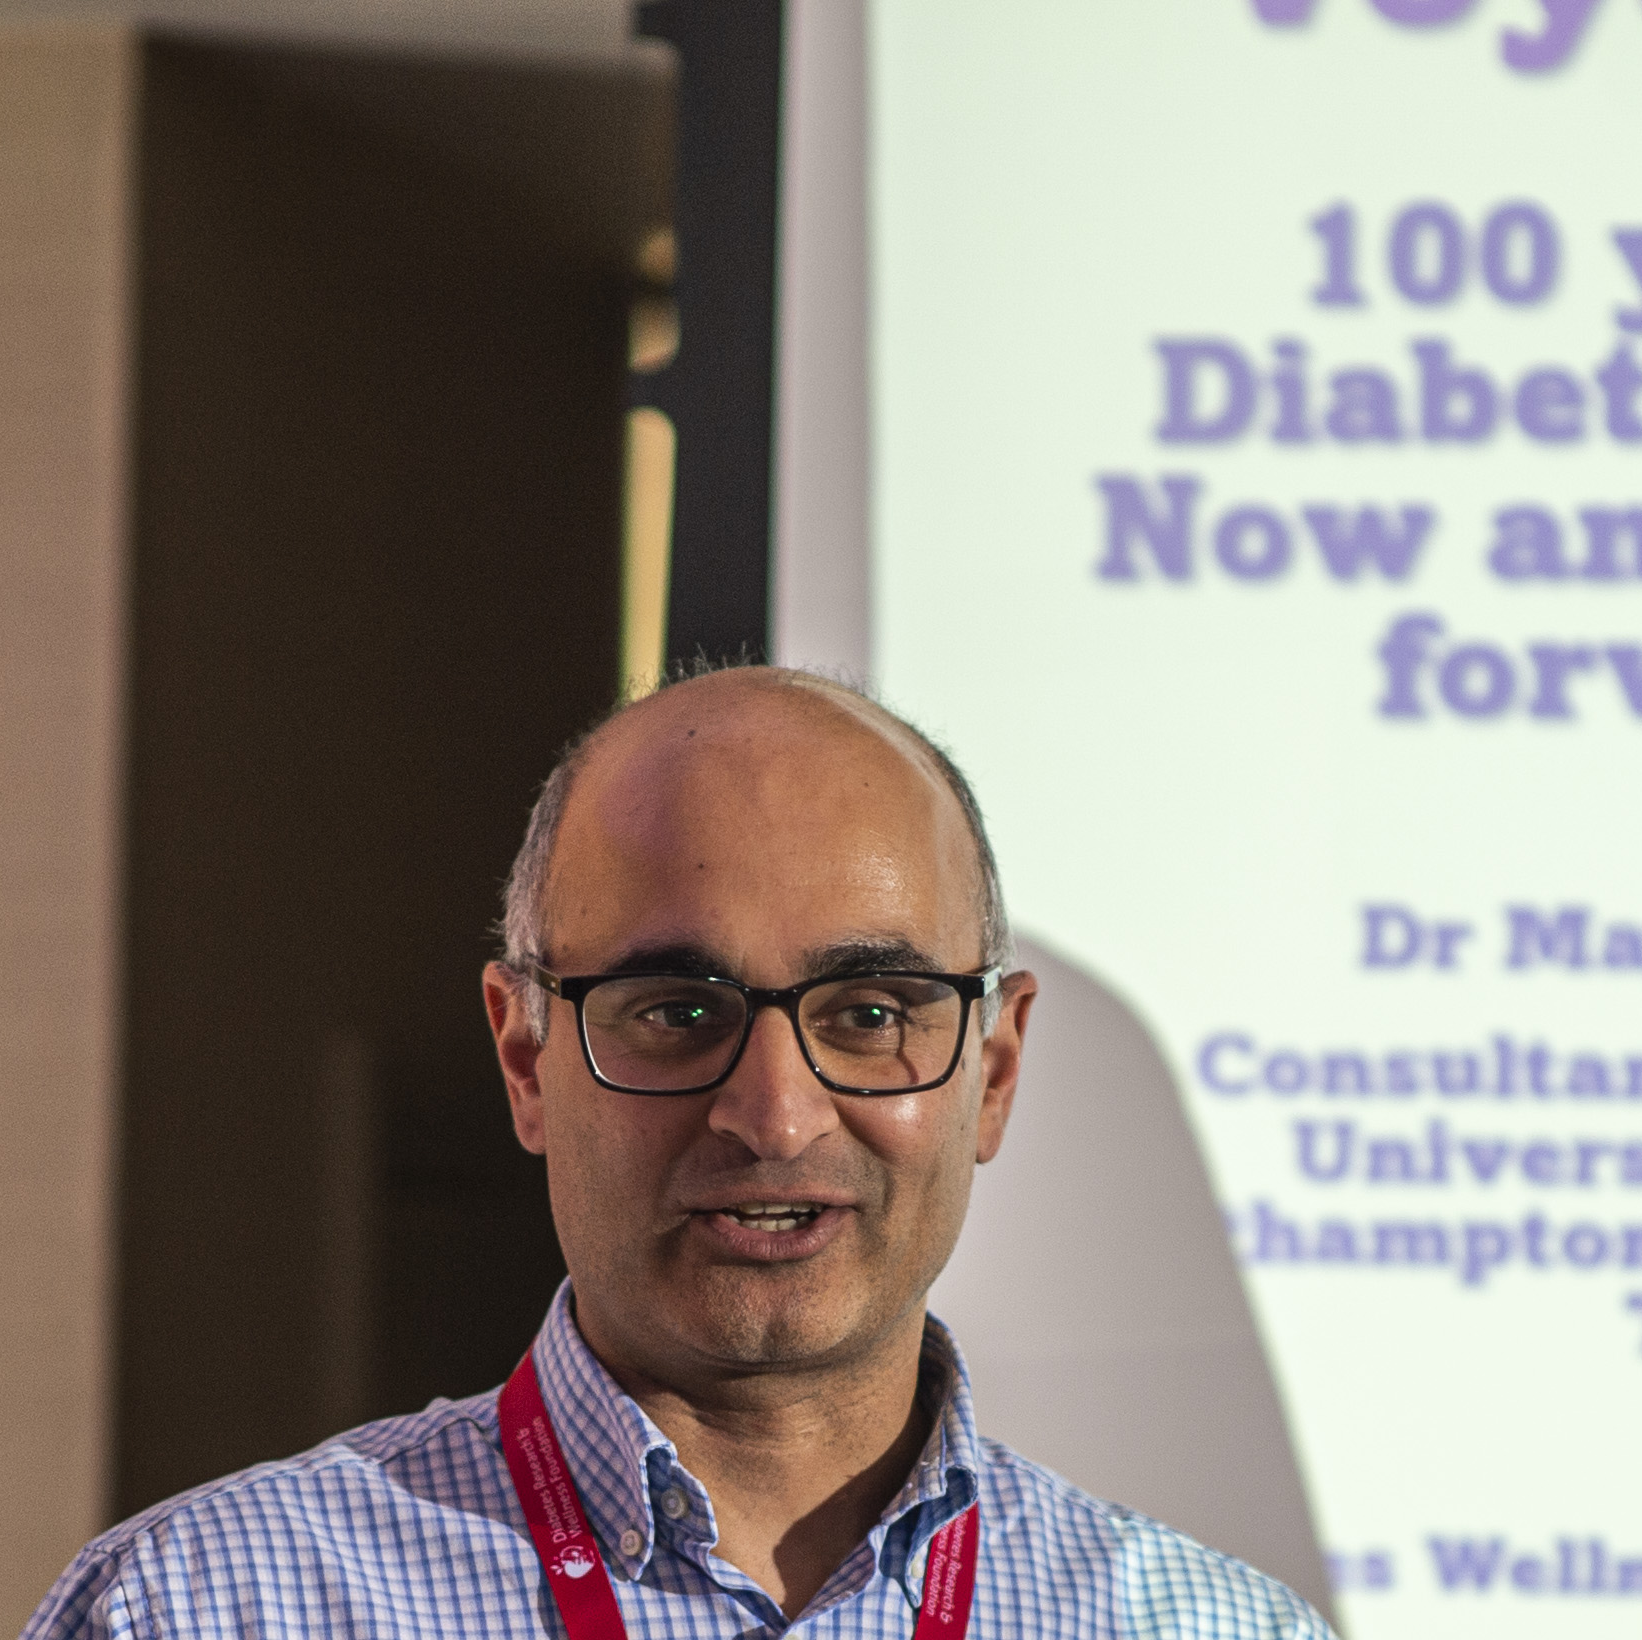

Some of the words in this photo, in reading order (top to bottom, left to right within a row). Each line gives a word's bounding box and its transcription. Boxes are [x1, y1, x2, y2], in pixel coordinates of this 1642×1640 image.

[1308, 199, 1564, 311] 100
[1093, 471, 1437, 586] Now
[1361, 904, 1471, 970] Dr
